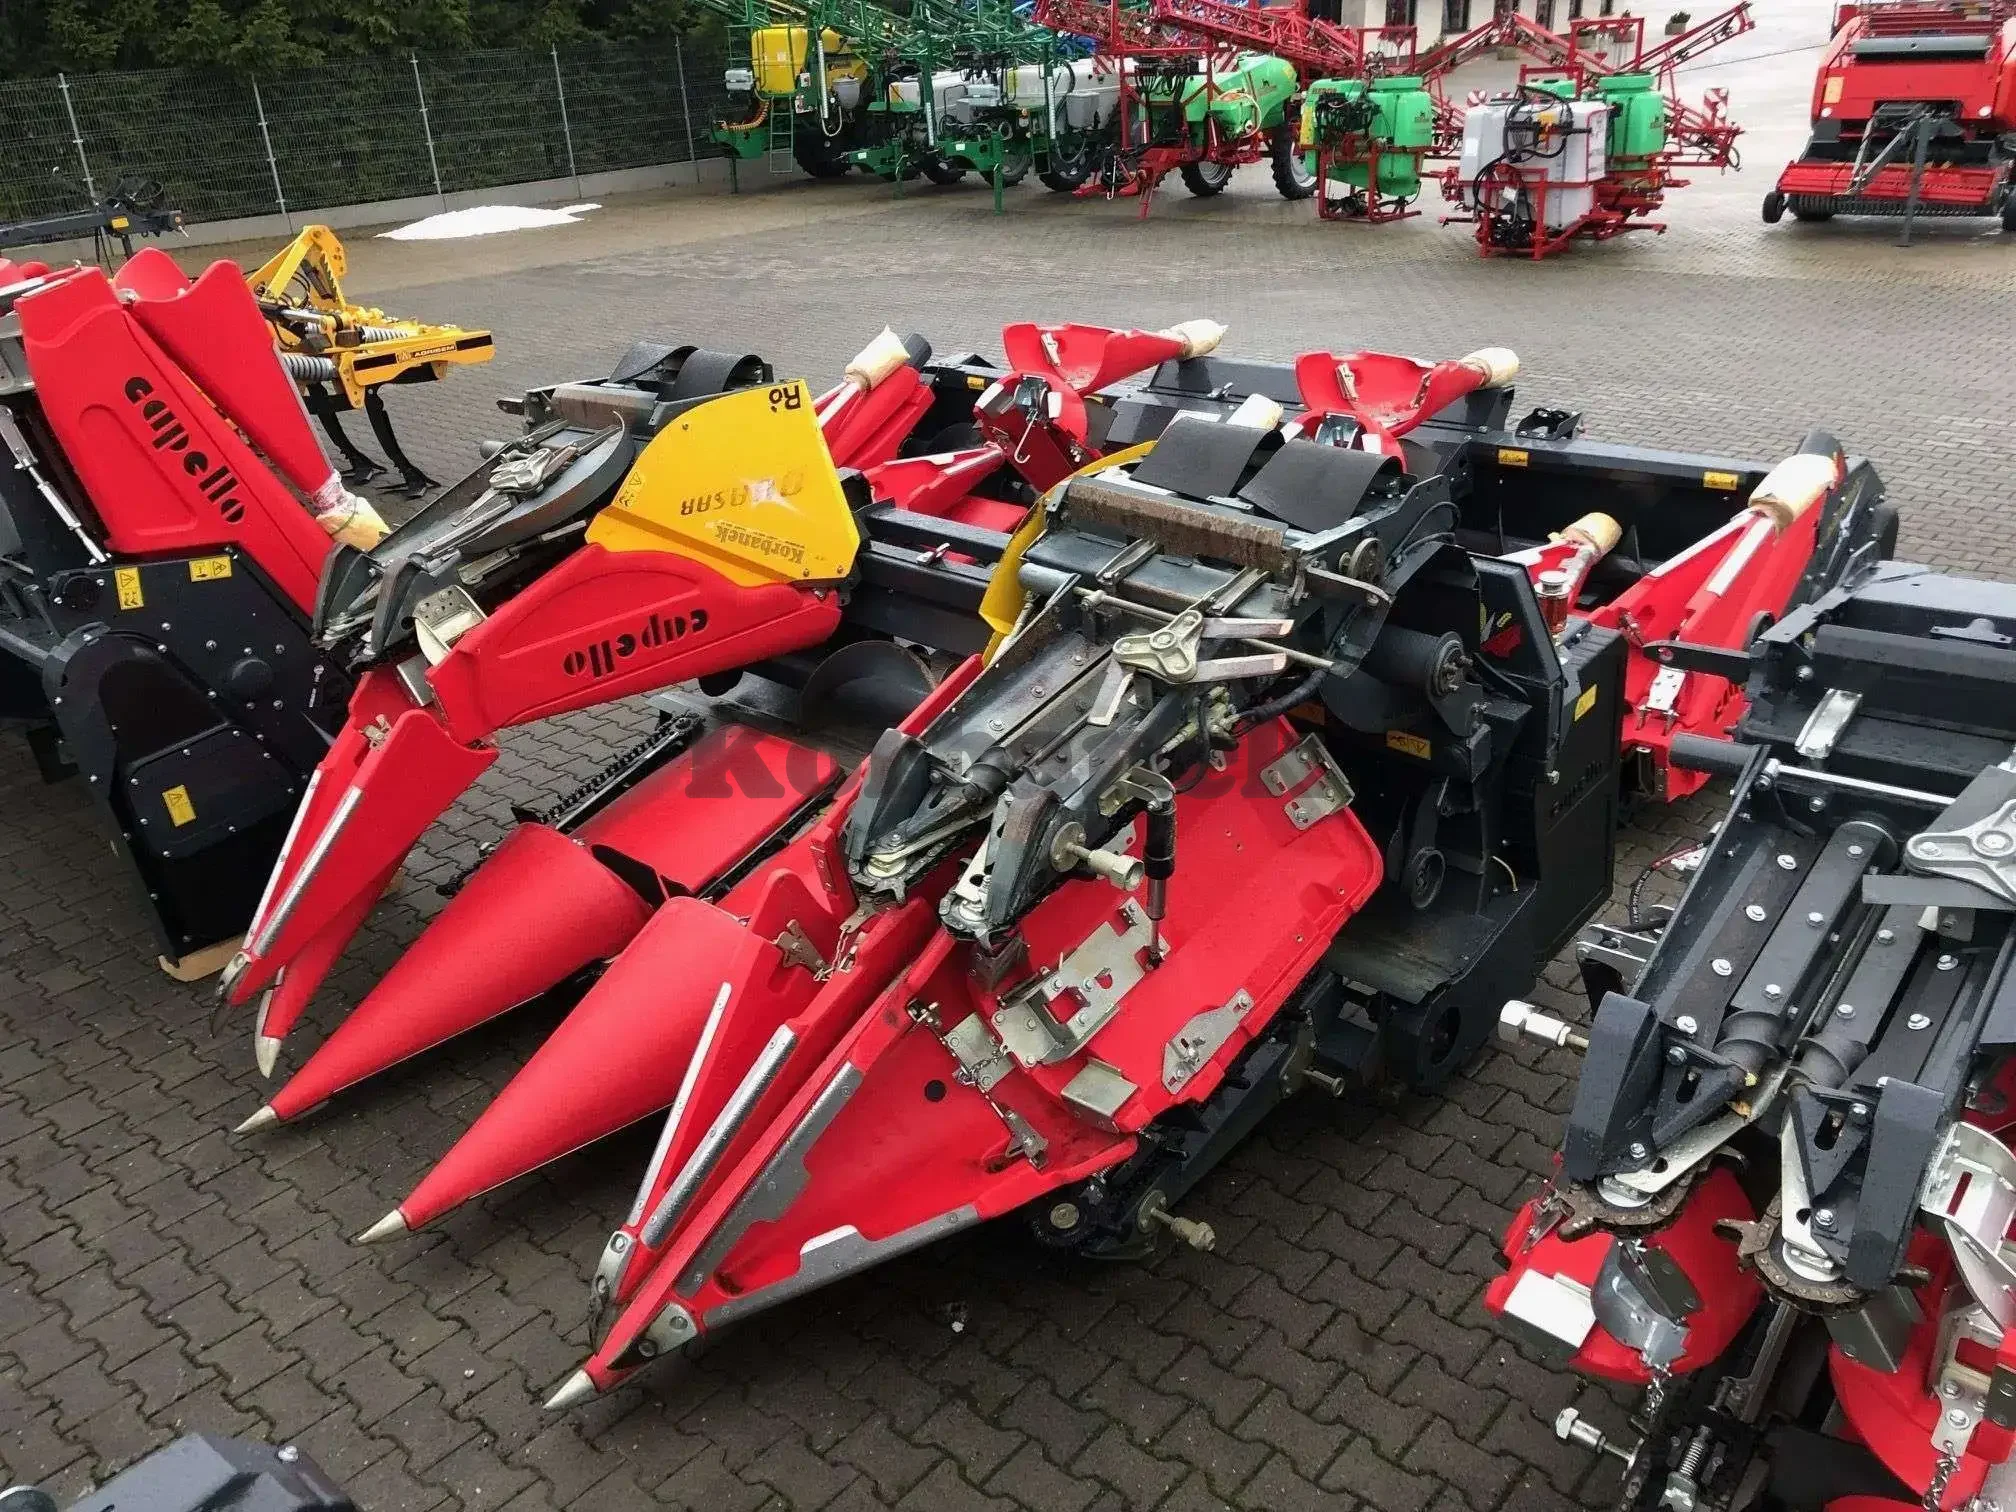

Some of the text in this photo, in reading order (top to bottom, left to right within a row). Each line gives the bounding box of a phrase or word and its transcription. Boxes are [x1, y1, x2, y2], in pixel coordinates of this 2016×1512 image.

[125, 376, 245, 524] capello
[714, 526, 804, 564] Korbanek
[564, 608, 709, 678] capello
